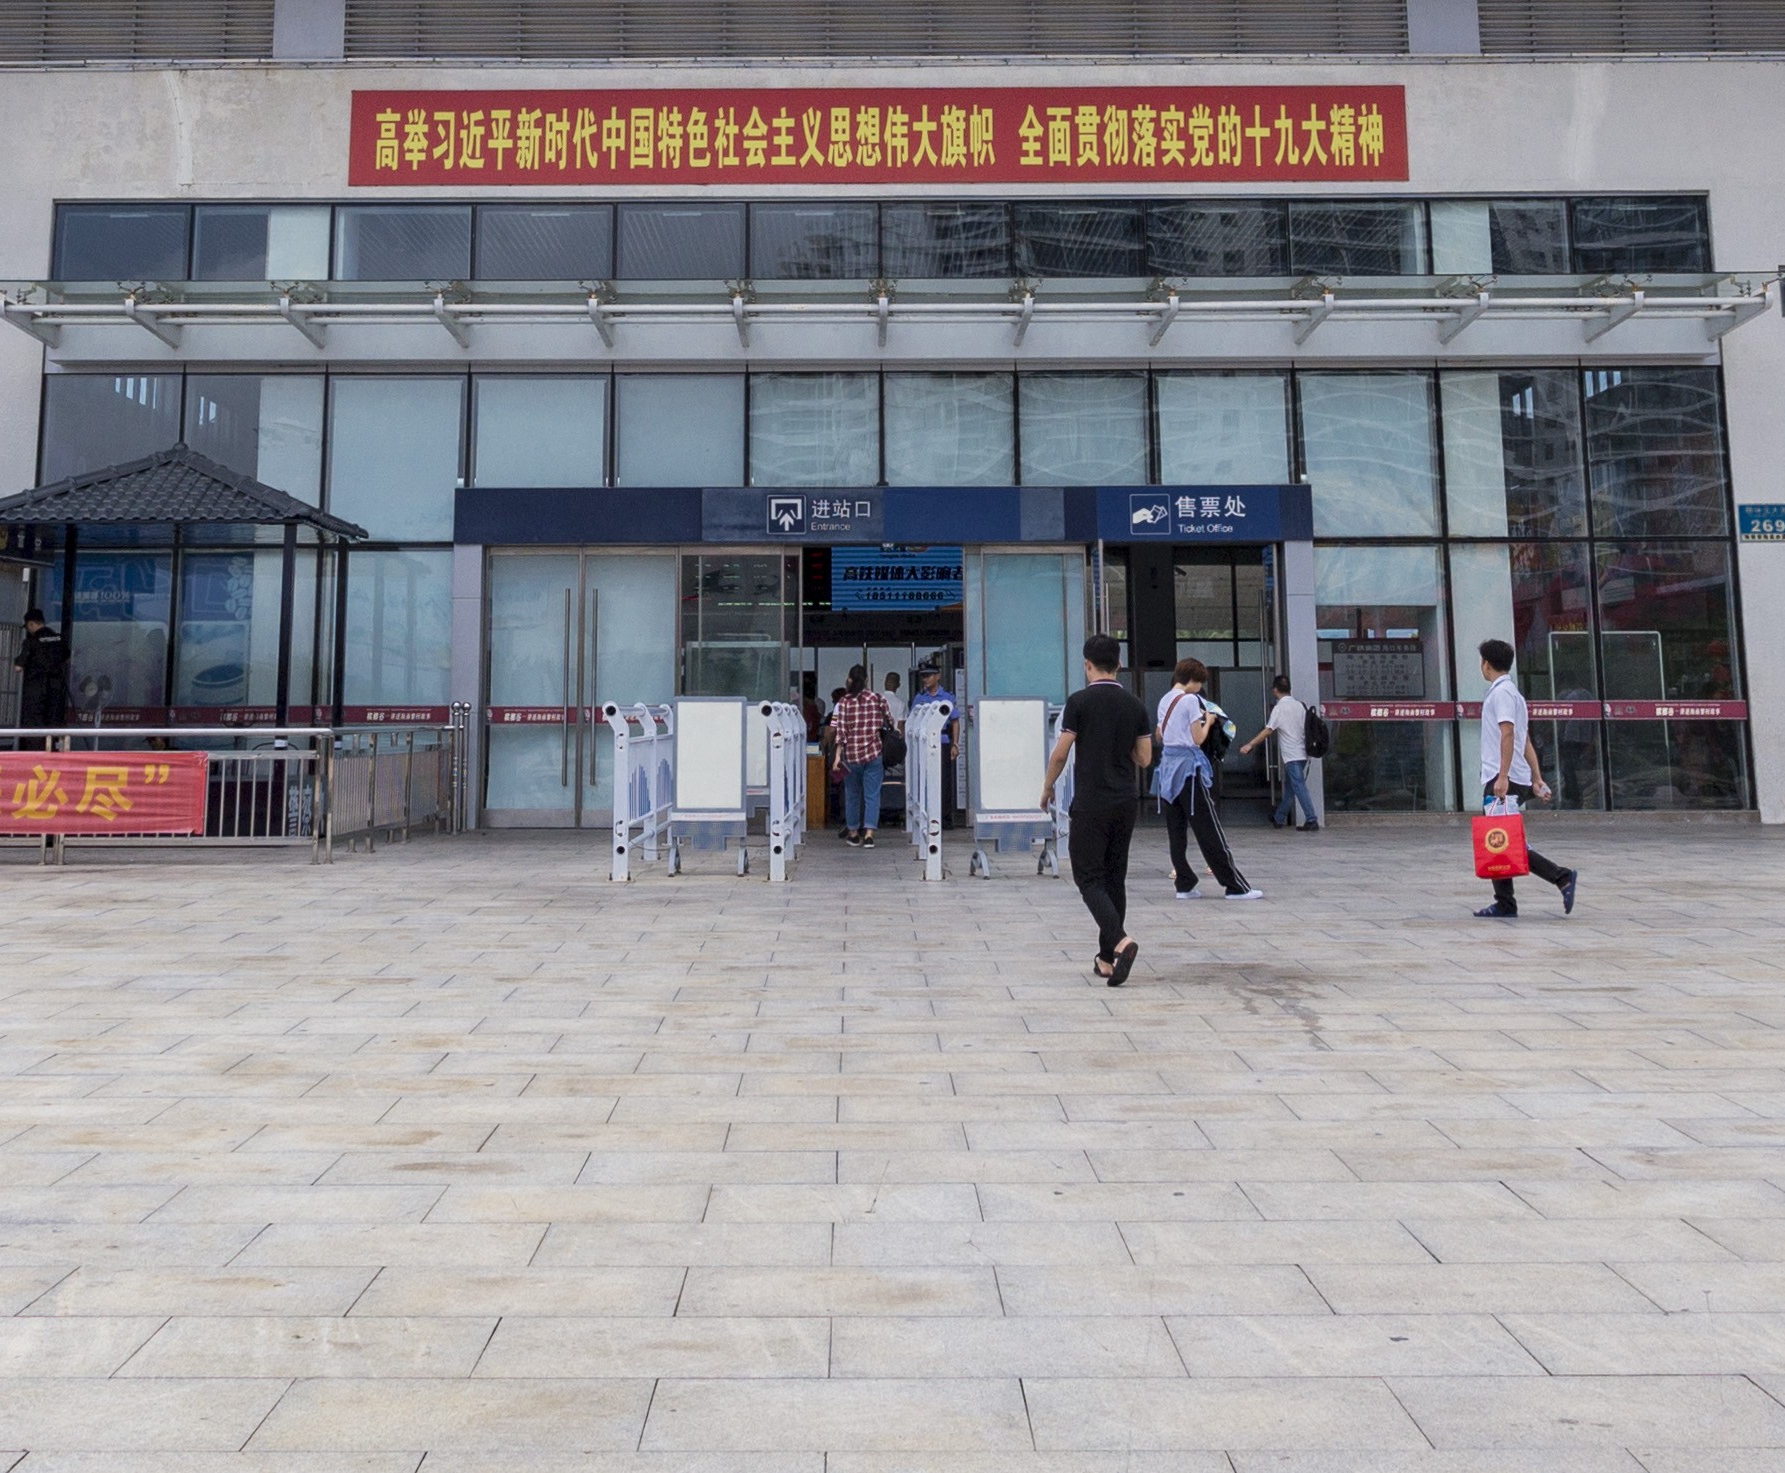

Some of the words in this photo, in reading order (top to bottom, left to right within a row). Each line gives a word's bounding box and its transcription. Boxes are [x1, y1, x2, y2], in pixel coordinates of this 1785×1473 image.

[375, 105, 996, 171] 高举习近平新时代中国特色社会主义思想伟大旗帜
[1018, 103, 1385, 168] 全面贯彻落实党的十九大精神
[811, 499, 871, 519] 进站口
[1174, 495, 1246, 518] 售票处
[810, 521, 851, 531] Entrance
[1177, 524, 1205, 534] Ticket
[1206, 523, 1234, 534] Office
[1750, 519, 1785, 532] 269
